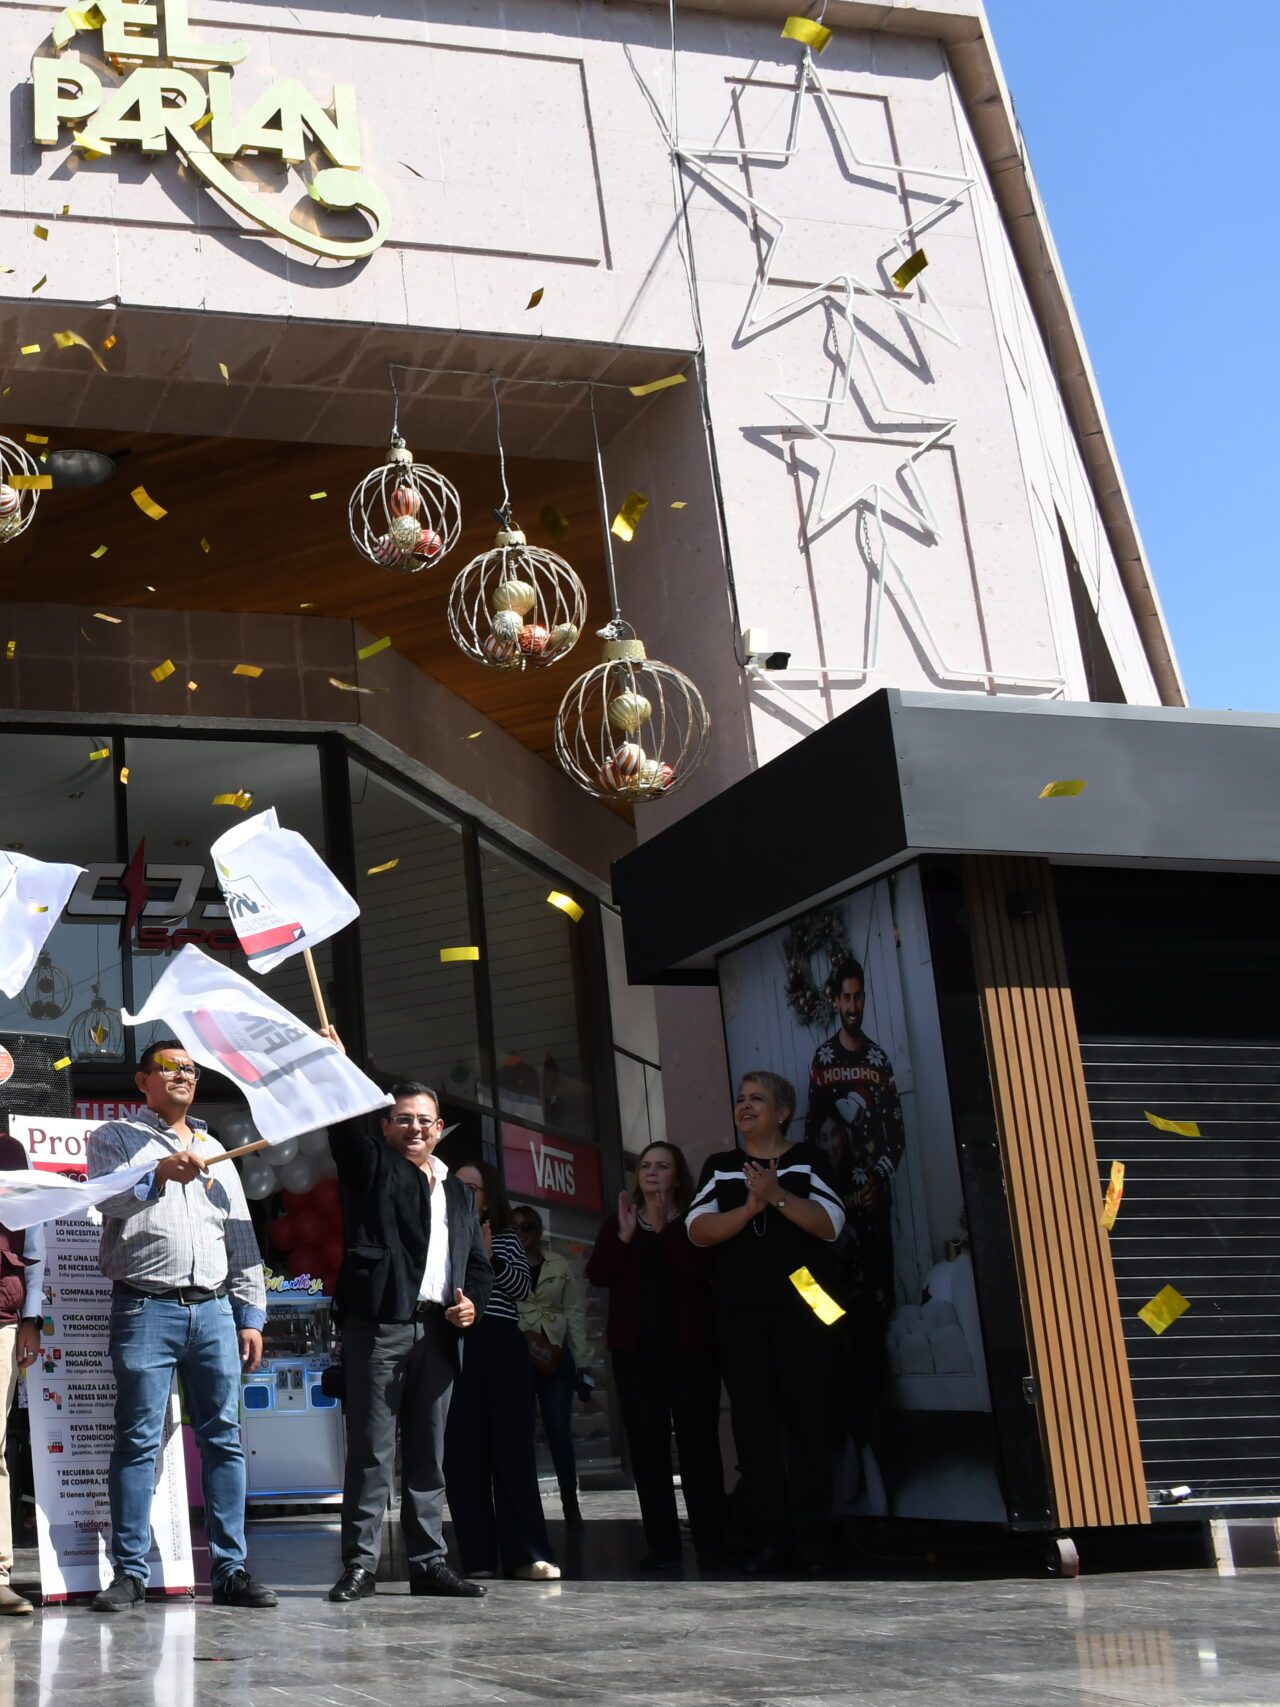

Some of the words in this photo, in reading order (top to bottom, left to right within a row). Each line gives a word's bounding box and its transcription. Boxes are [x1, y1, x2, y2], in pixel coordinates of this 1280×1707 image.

[138, 927, 241, 950] SPO
[823, 1067, 880, 1084] HOHOHO
[76, 1103, 147, 1121] TIEN
[27, 1128, 93, 1156] Prof
[530, 1141, 576, 1196] VANS
[60, 1288, 94, 1296] COMPARA
[95, 1289, 113, 1297] PREC
[65, 1359, 102, 1367] ENGAÑOSA
[74, 1393, 95, 1401] MESES
[70, 1478, 101, 1486] COMPRA,
[85, 1490, 106, 1498] alguna
